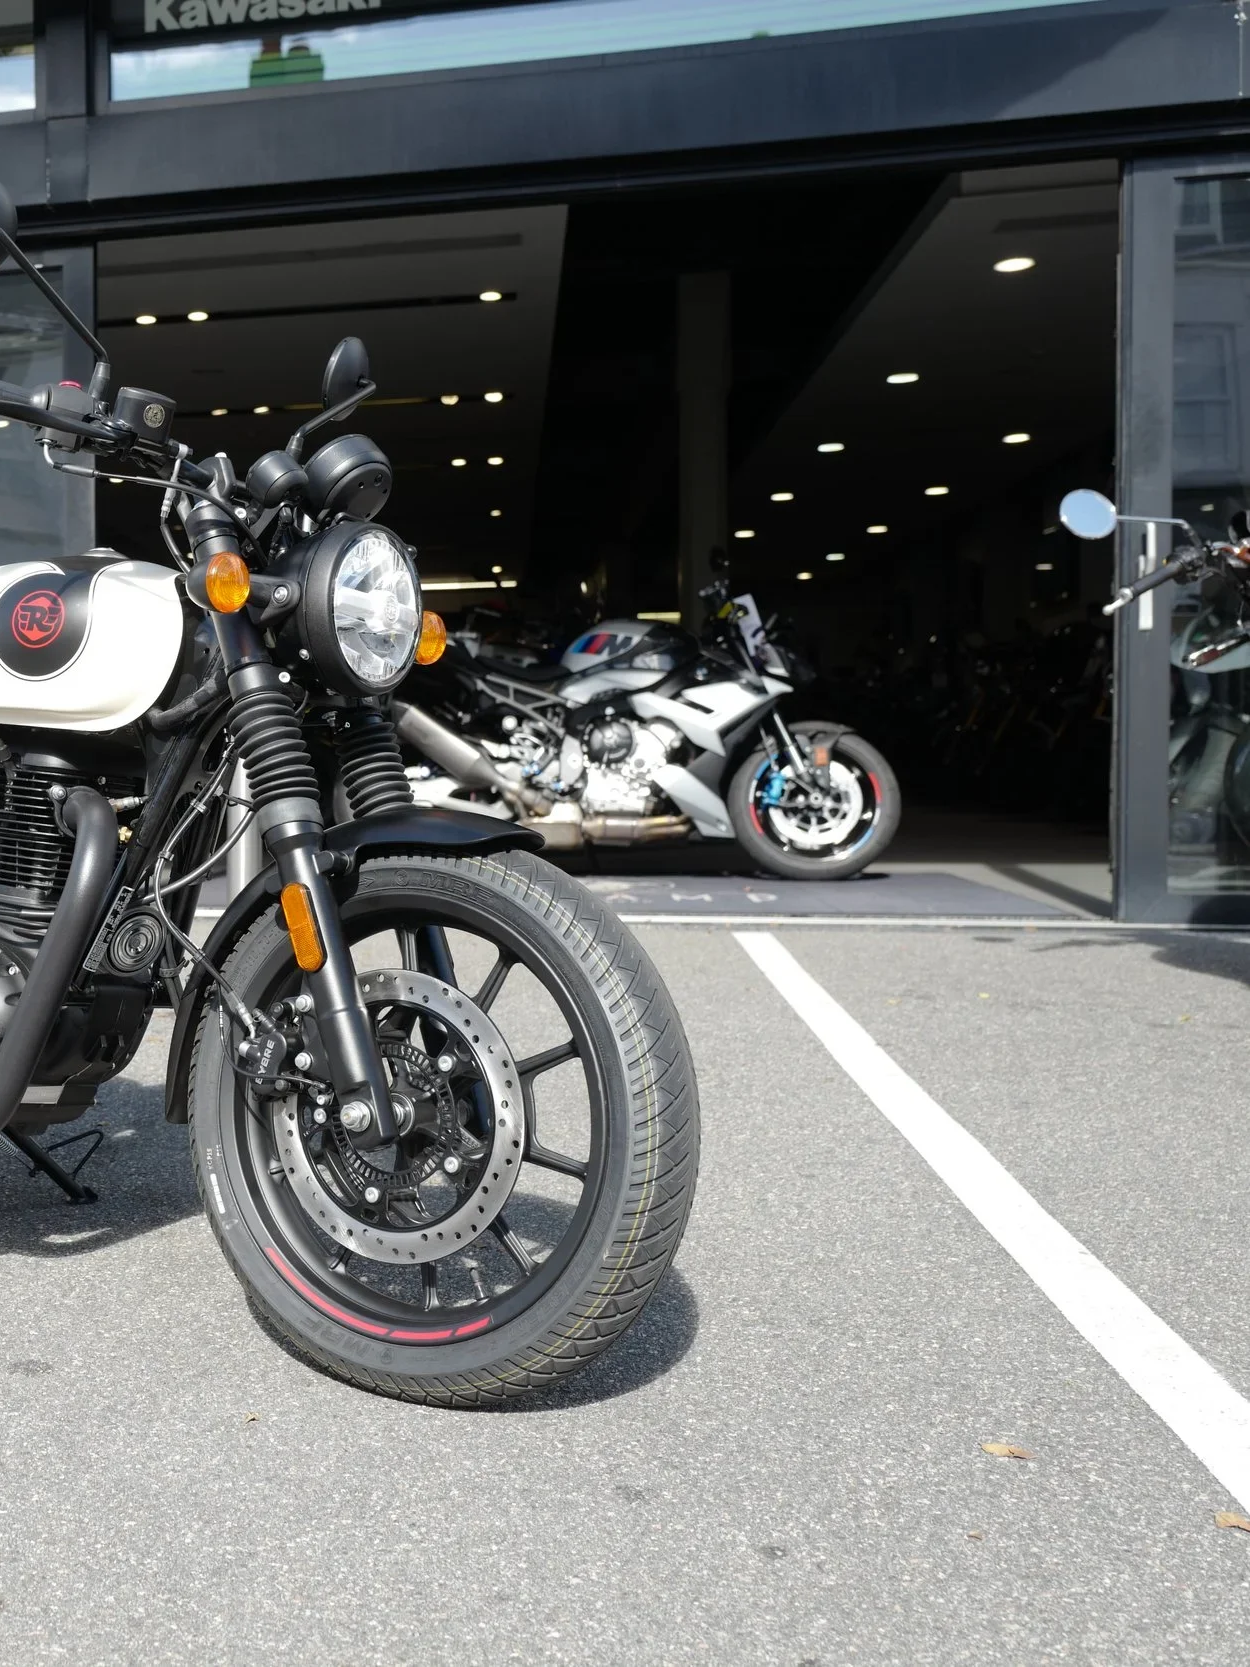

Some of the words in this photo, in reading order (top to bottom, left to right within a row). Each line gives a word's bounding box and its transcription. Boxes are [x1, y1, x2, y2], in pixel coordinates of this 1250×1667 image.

[144, 0, 381, 33] Kawas
[420, 872, 493, 901] MRF
[298, 1317, 372, 1359] MRF
